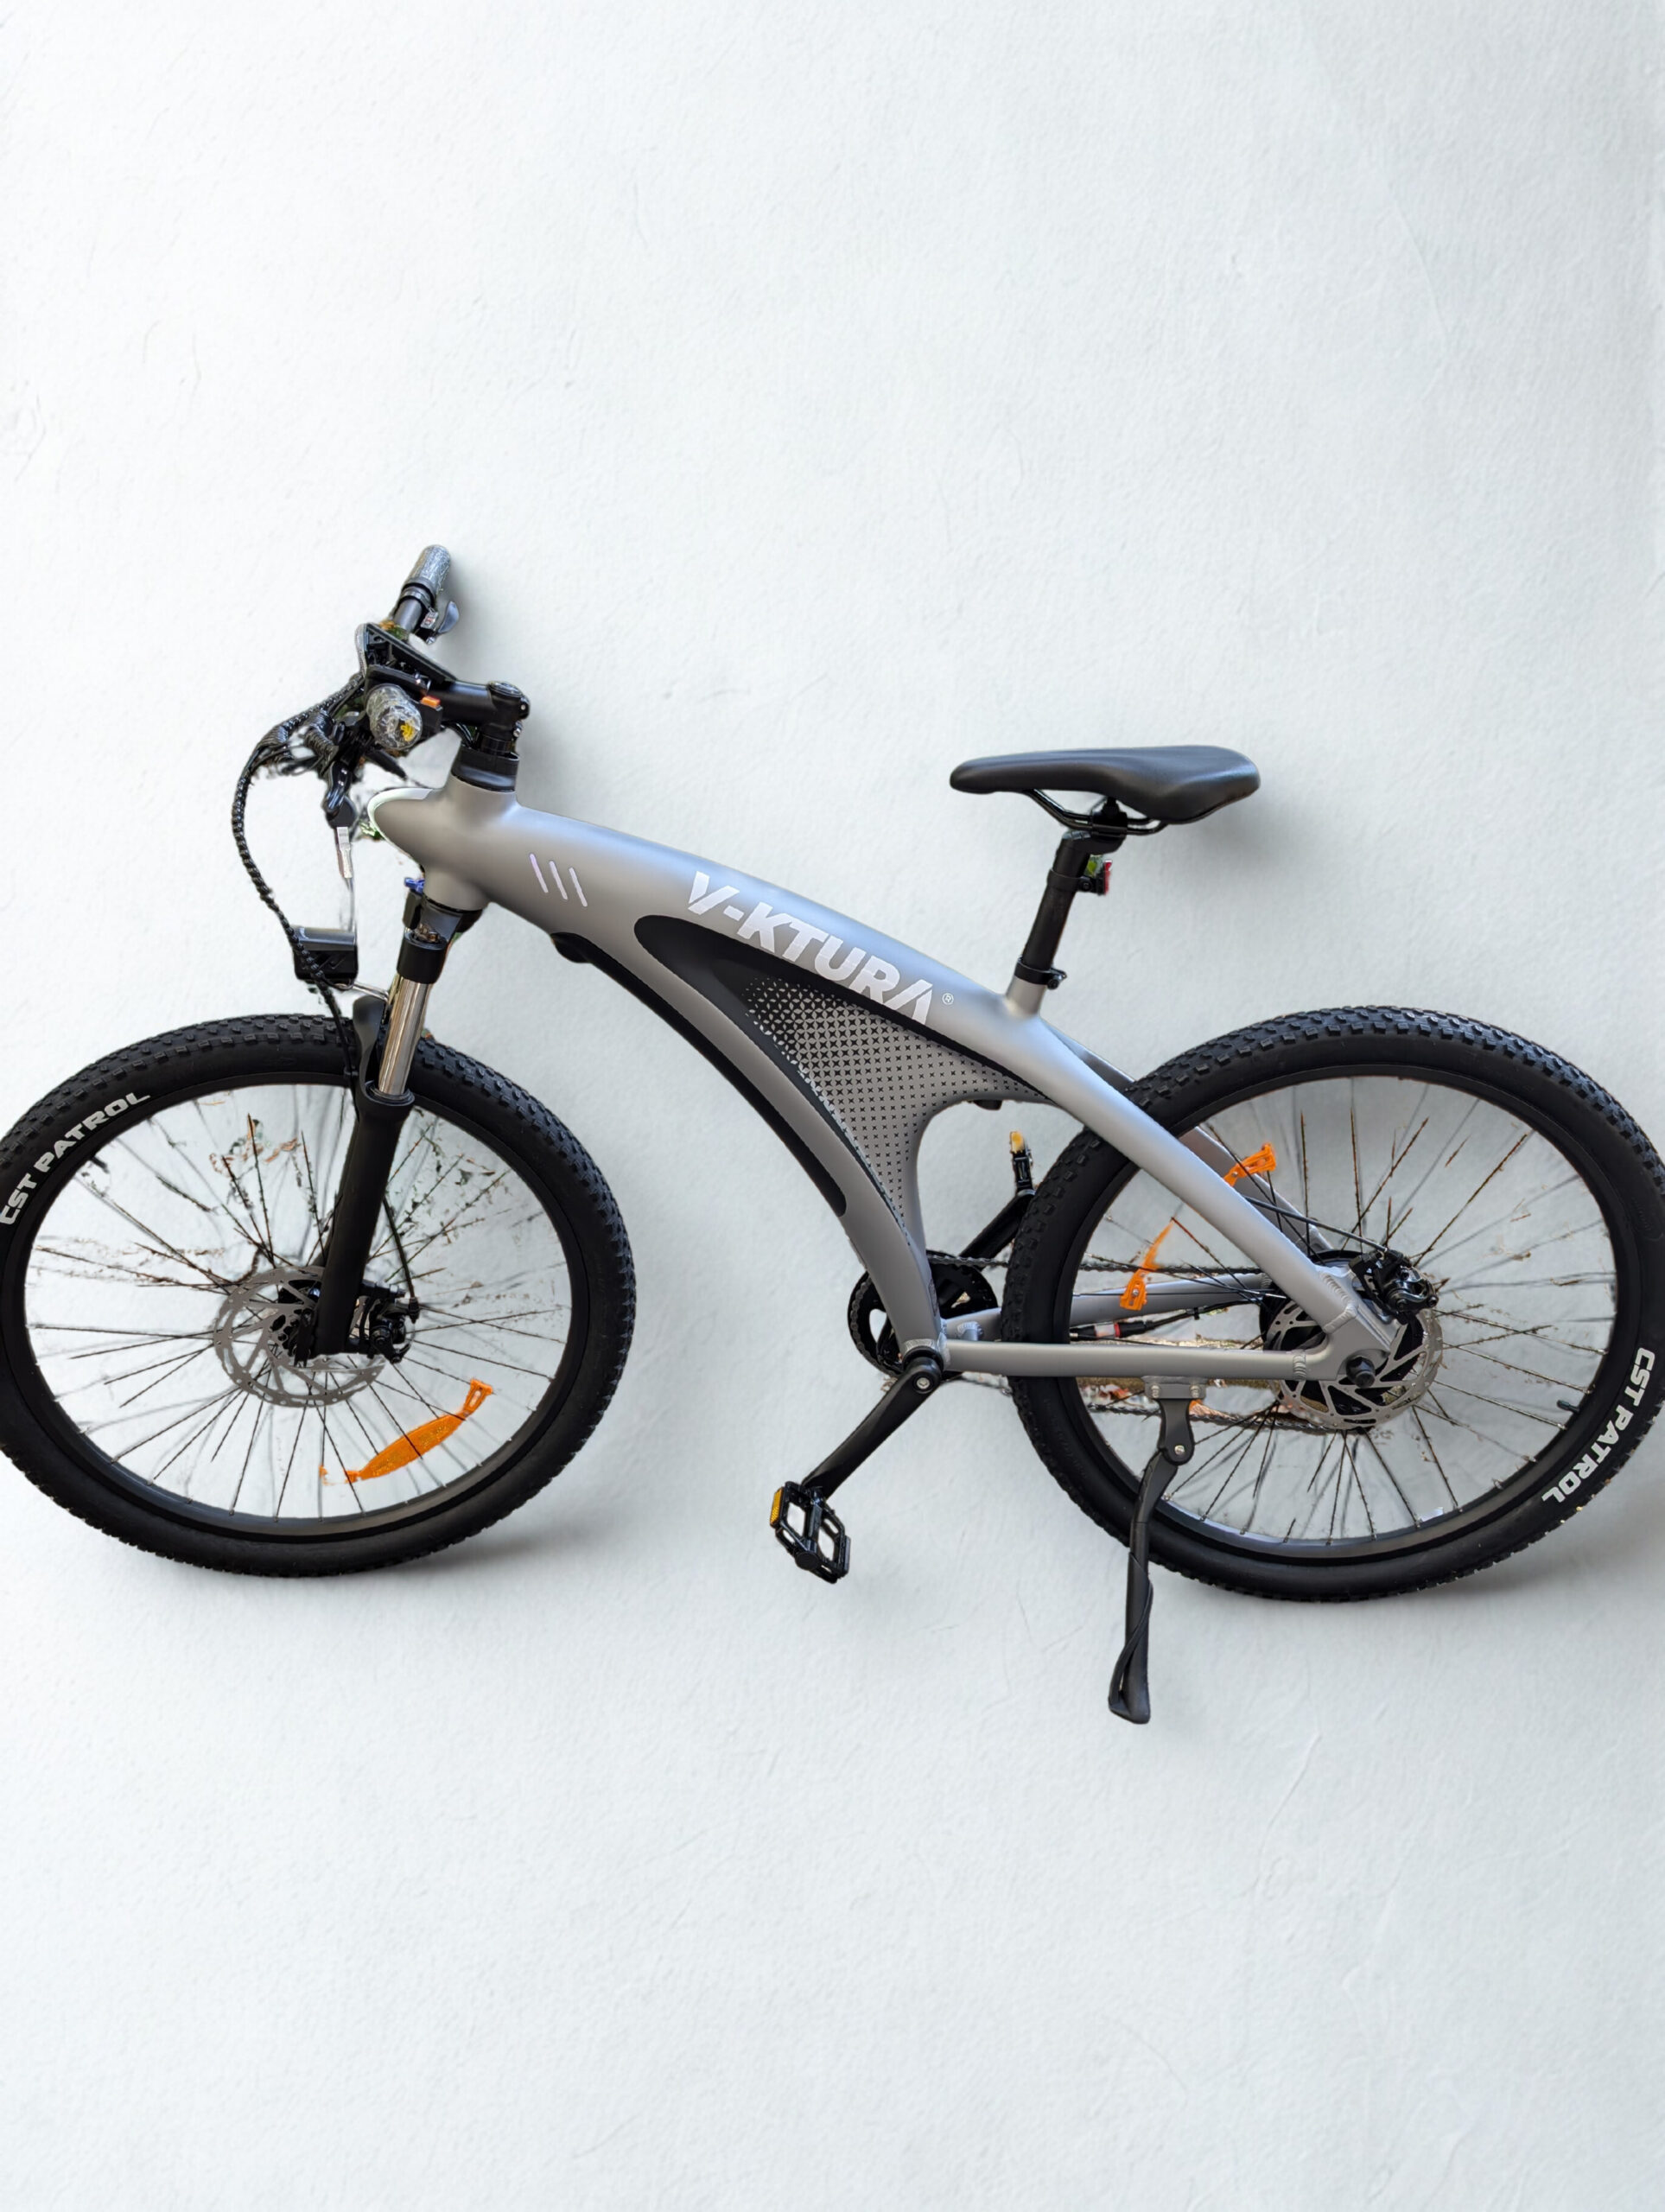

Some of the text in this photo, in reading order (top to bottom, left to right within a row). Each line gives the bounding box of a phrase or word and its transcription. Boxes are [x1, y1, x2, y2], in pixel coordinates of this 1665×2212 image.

[688, 870, 933, 1026] V-KTURA
[0, 1092, 151, 1225] CST PATROL
[1541, 1347, 1655, 1503] CST PATROL
